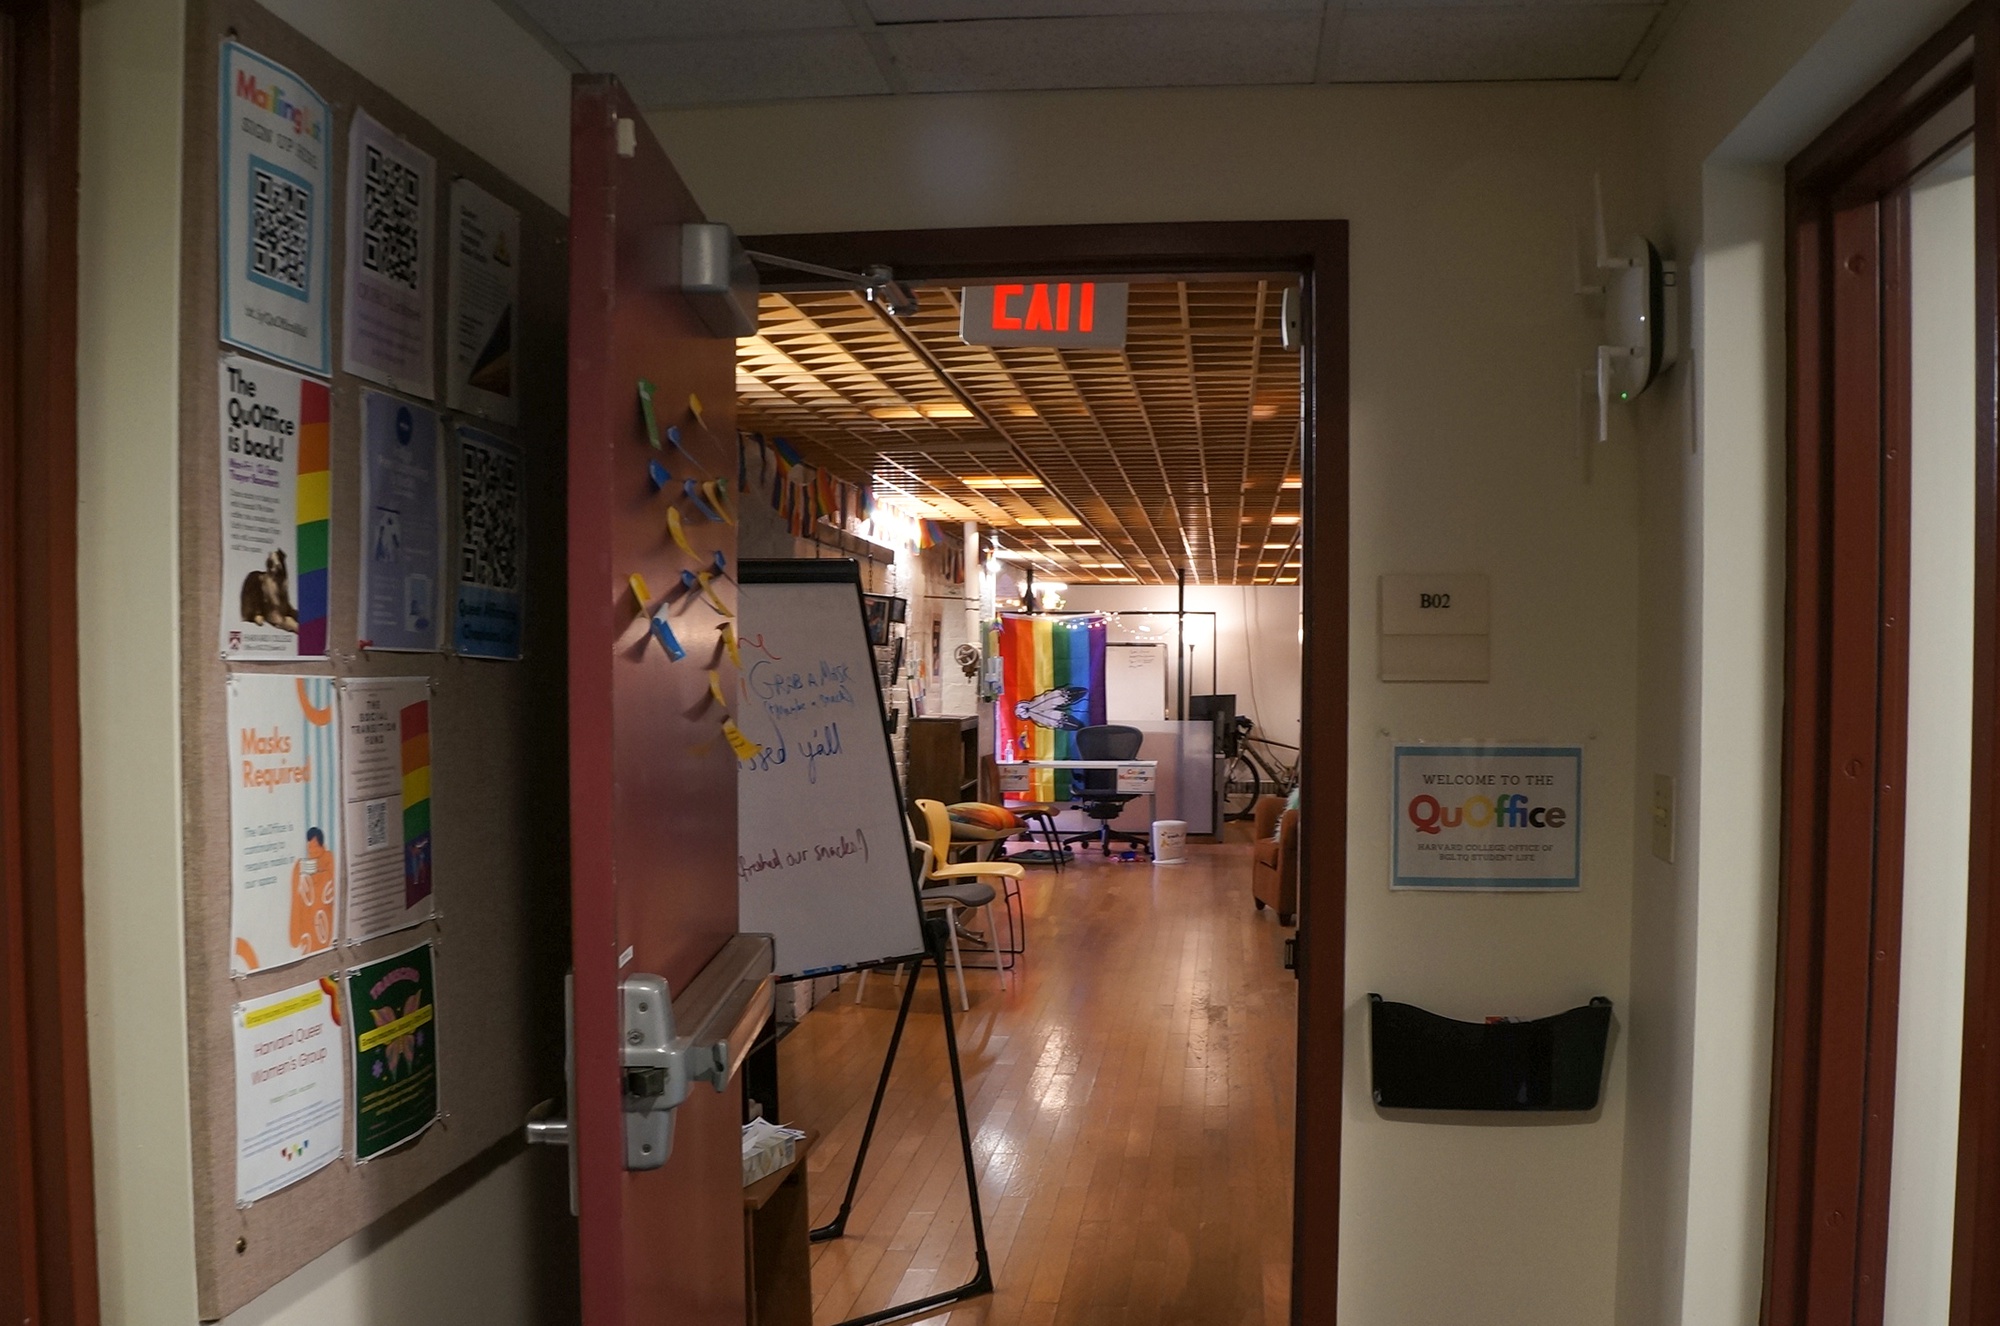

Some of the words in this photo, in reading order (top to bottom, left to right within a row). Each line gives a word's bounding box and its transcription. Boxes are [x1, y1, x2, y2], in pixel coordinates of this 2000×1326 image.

[227, 367, 257, 397] The
[228, 398, 295, 435] QuOffice
[228, 427, 240, 453] is
[244, 430, 283, 462] back!
[1420, 594, 1451, 608] B02
[242, 725, 291, 755] Masks
[798, 722, 843, 785] y'all
[243, 755, 311, 794] Required
[1422, 774, 1495, 785] WELCOME
[1500, 775, 1520, 785] TO
[1525, 775, 1554, 785] THE
[1408, 793, 1567, 834] QuOffice
[787, 849, 808, 867] our
[1439, 854, 1470, 862] BGLTQ
[1471, 854, 1513, 862] STUDENT
[1516, 854, 1536, 862] LIFE
[1509, 844, 1540, 852] OFFICE
[254, 1030, 294, 1057] Harvard
[296, 1023, 323, 1043] Queer
[251, 1055, 297, 1085] Women's
[299, 1047, 327, 1067] Group
